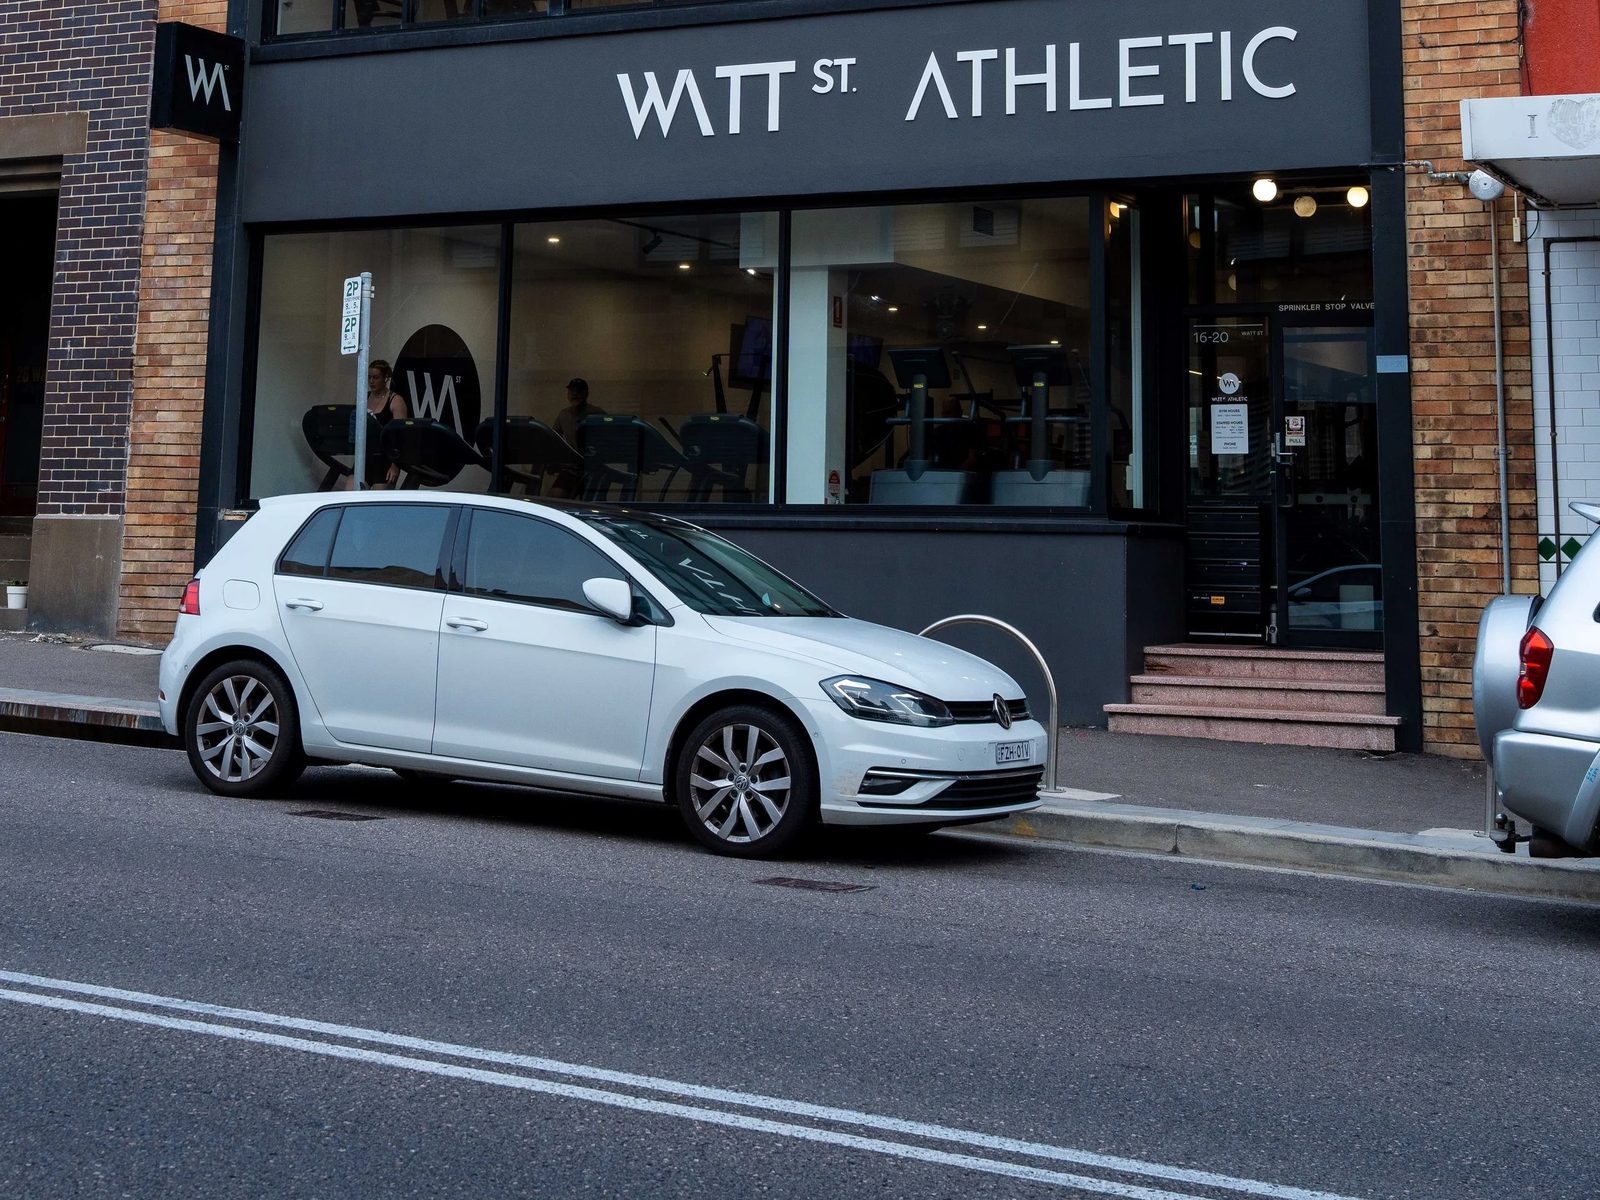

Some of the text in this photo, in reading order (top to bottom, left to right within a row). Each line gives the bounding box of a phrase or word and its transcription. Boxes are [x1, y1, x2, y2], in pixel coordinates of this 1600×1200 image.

[617, 26, 1298, 140] WATT ST. ATHLETIC
[346, 281, 358, 296] 2P
[1350, 302, 1375, 310] VALVE
[344, 318, 356, 332] 2P
[1193, 332, 1229, 343] 16-20
